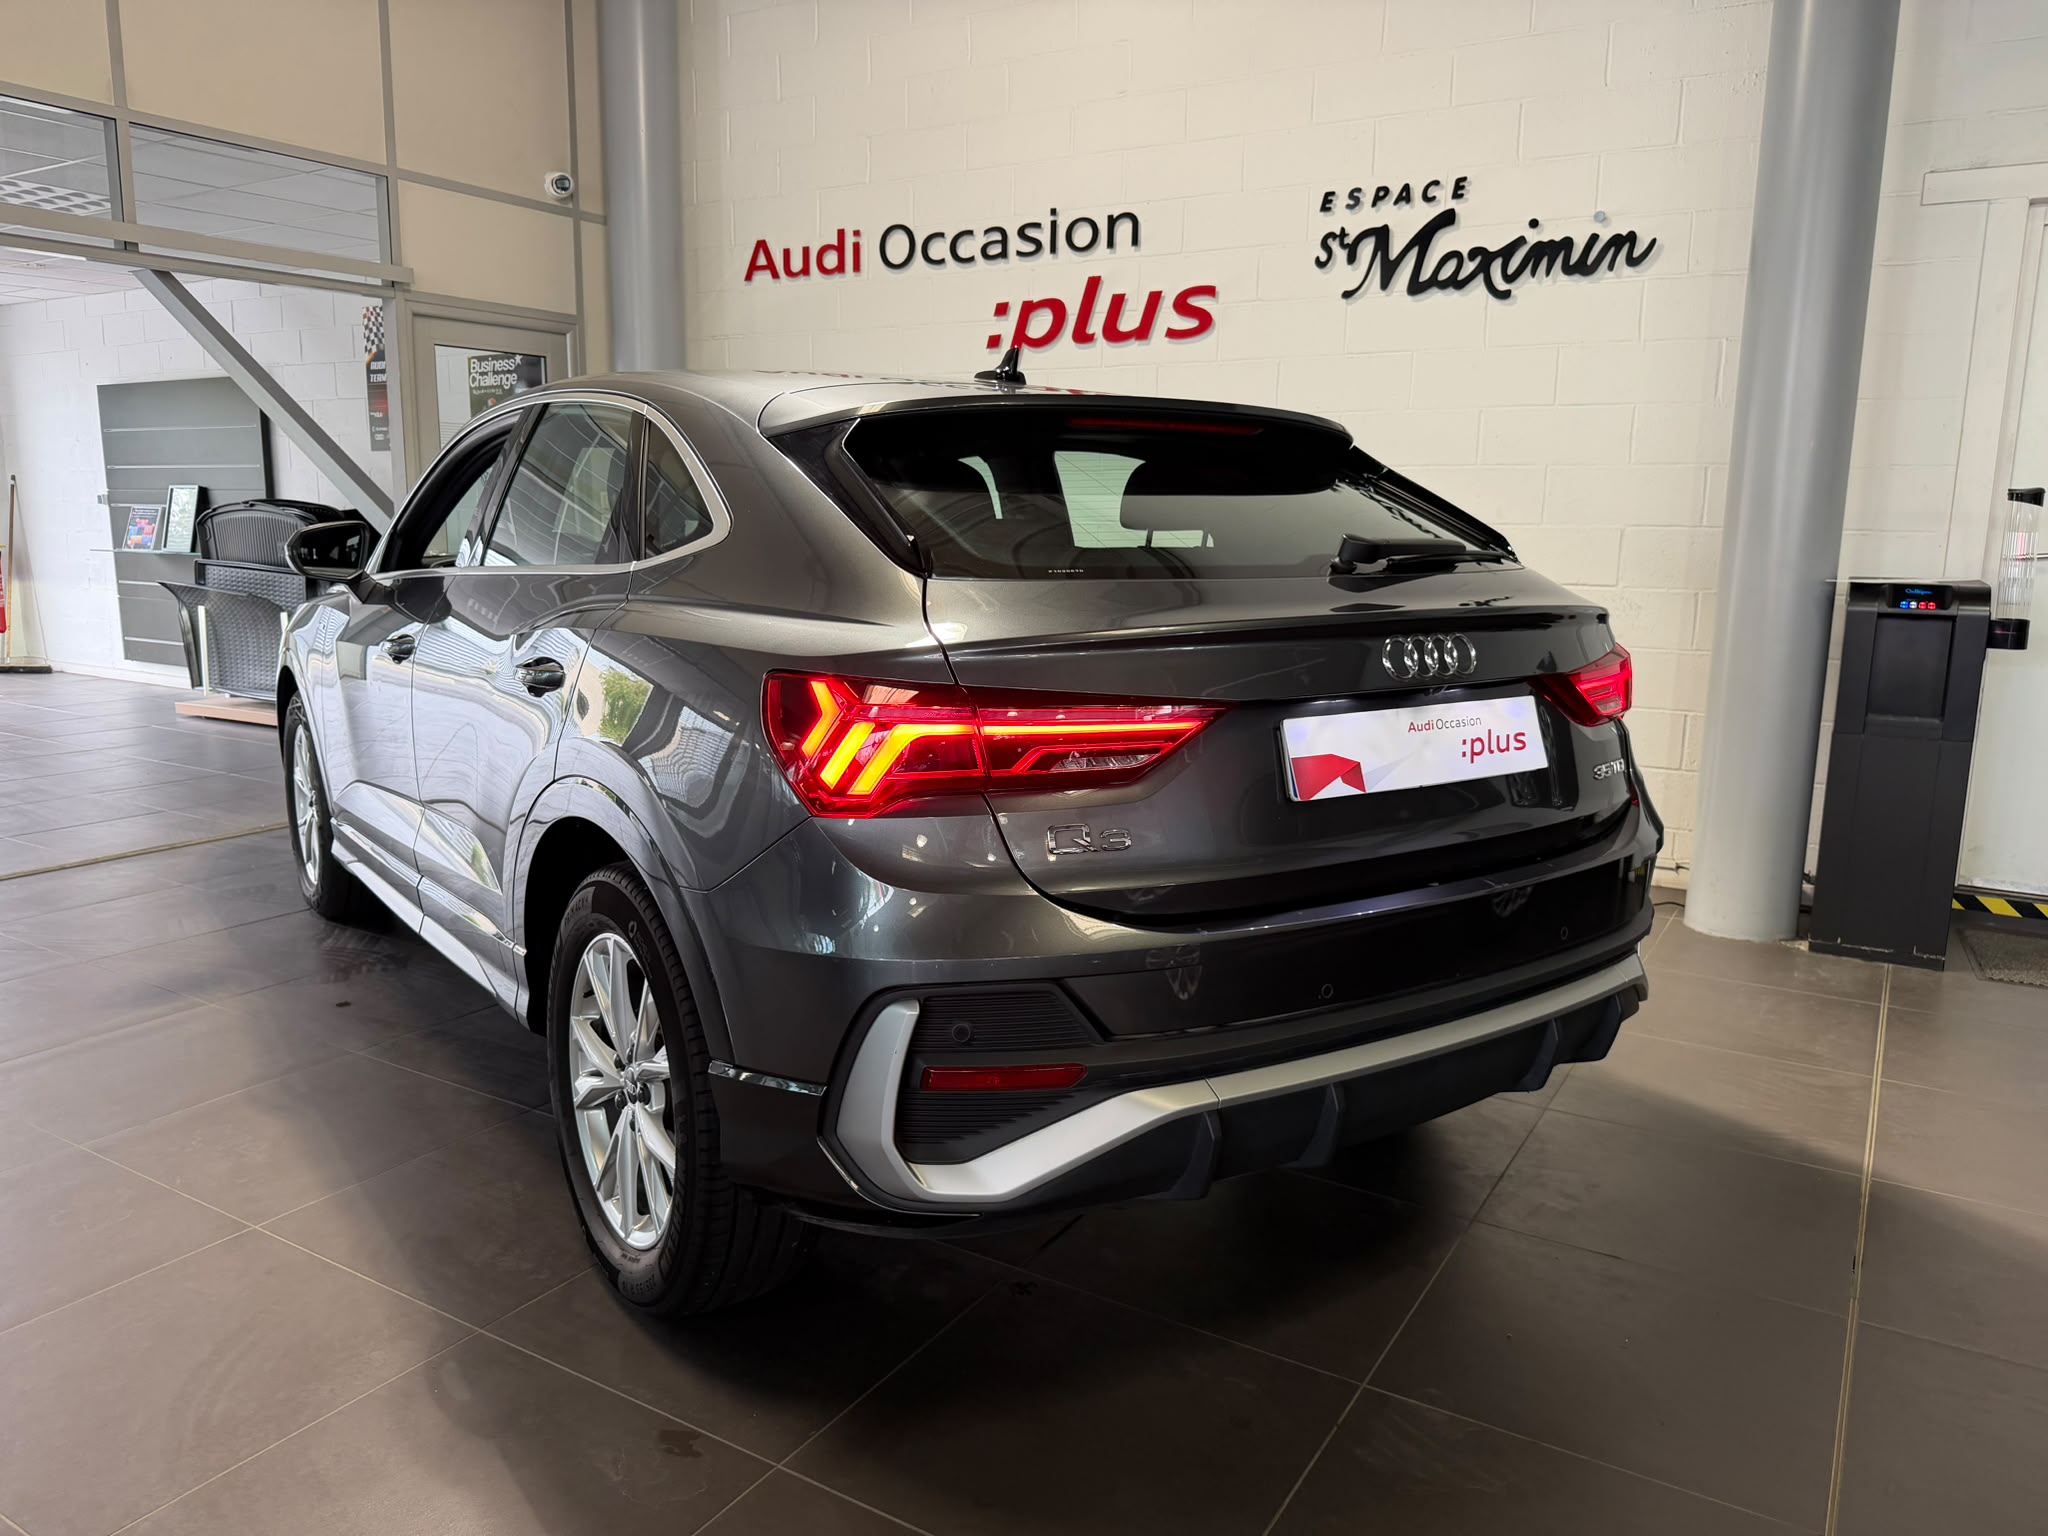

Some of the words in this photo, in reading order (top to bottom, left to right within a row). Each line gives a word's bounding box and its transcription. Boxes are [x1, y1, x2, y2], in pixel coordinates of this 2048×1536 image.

[1319, 176, 1468, 213] ESPACE
[743, 228, 862, 283] Audi
[878, 208, 1141, 271] Occasion
[1314, 226, 1350, 270] St
[1341, 207, 1657, 300] Maximin
[986, 275, 1218, 350] :plus
[469, 370, 518, 389] Challenge
[470, 357, 515, 373] Business
[1407, 719, 1435, 733] Audi
[1435, 715, 1482, 731] Occasion
[1461, 728, 1527, 764] :plus
[1047, 823, 1132, 855] Q3
